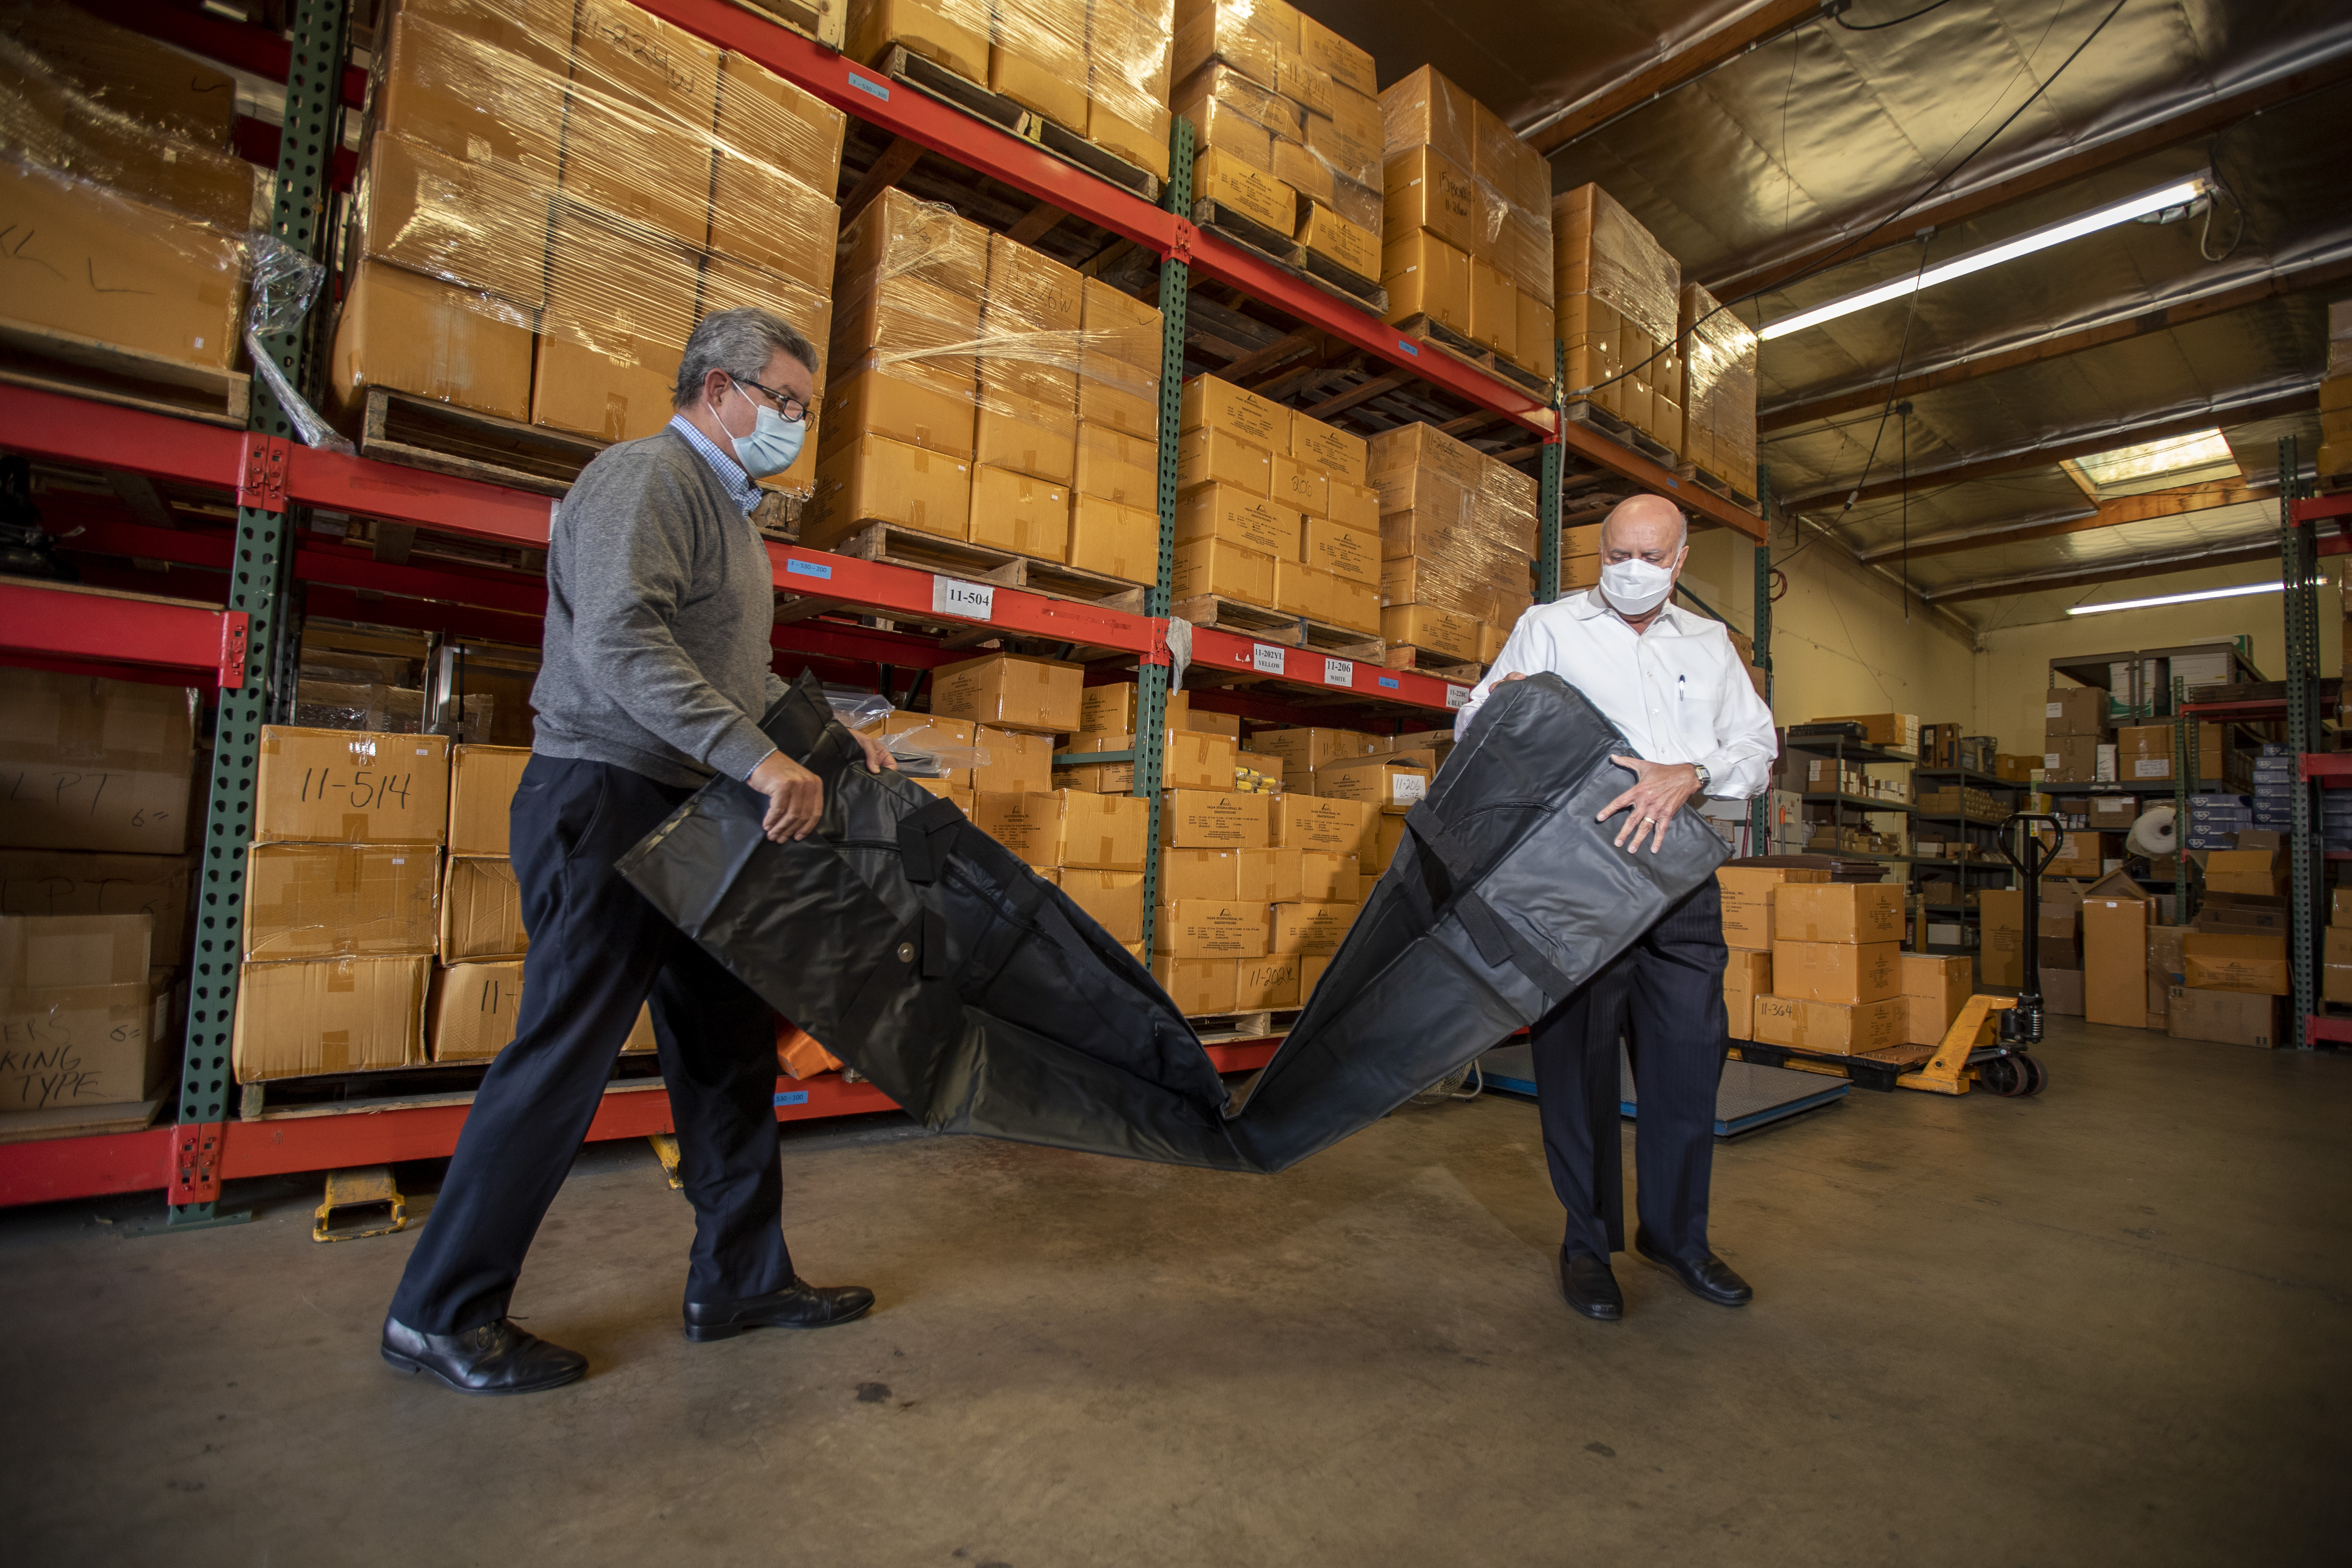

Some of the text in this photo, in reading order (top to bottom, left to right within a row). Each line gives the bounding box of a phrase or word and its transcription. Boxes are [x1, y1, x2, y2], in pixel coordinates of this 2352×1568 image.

[1291, 476, 1312, 497] 206
[949, 589, 990, 606] 11-504
[1255, 648, 1283, 660] 11-202YL
[1259, 660, 1280, 669] YELLOW
[1327, 661, 1351, 673] 11-206
[1450, 689, 1468, 698] 11-228C
[302, 768, 410, 809] 11-514
[1396, 778, 1421, 790] 11-206
[1250, 967, 1295, 987] 11-202YL
[1761, 1002, 1792, 1019] 11-364
[13, 1071, 107, 1109] TYPE
